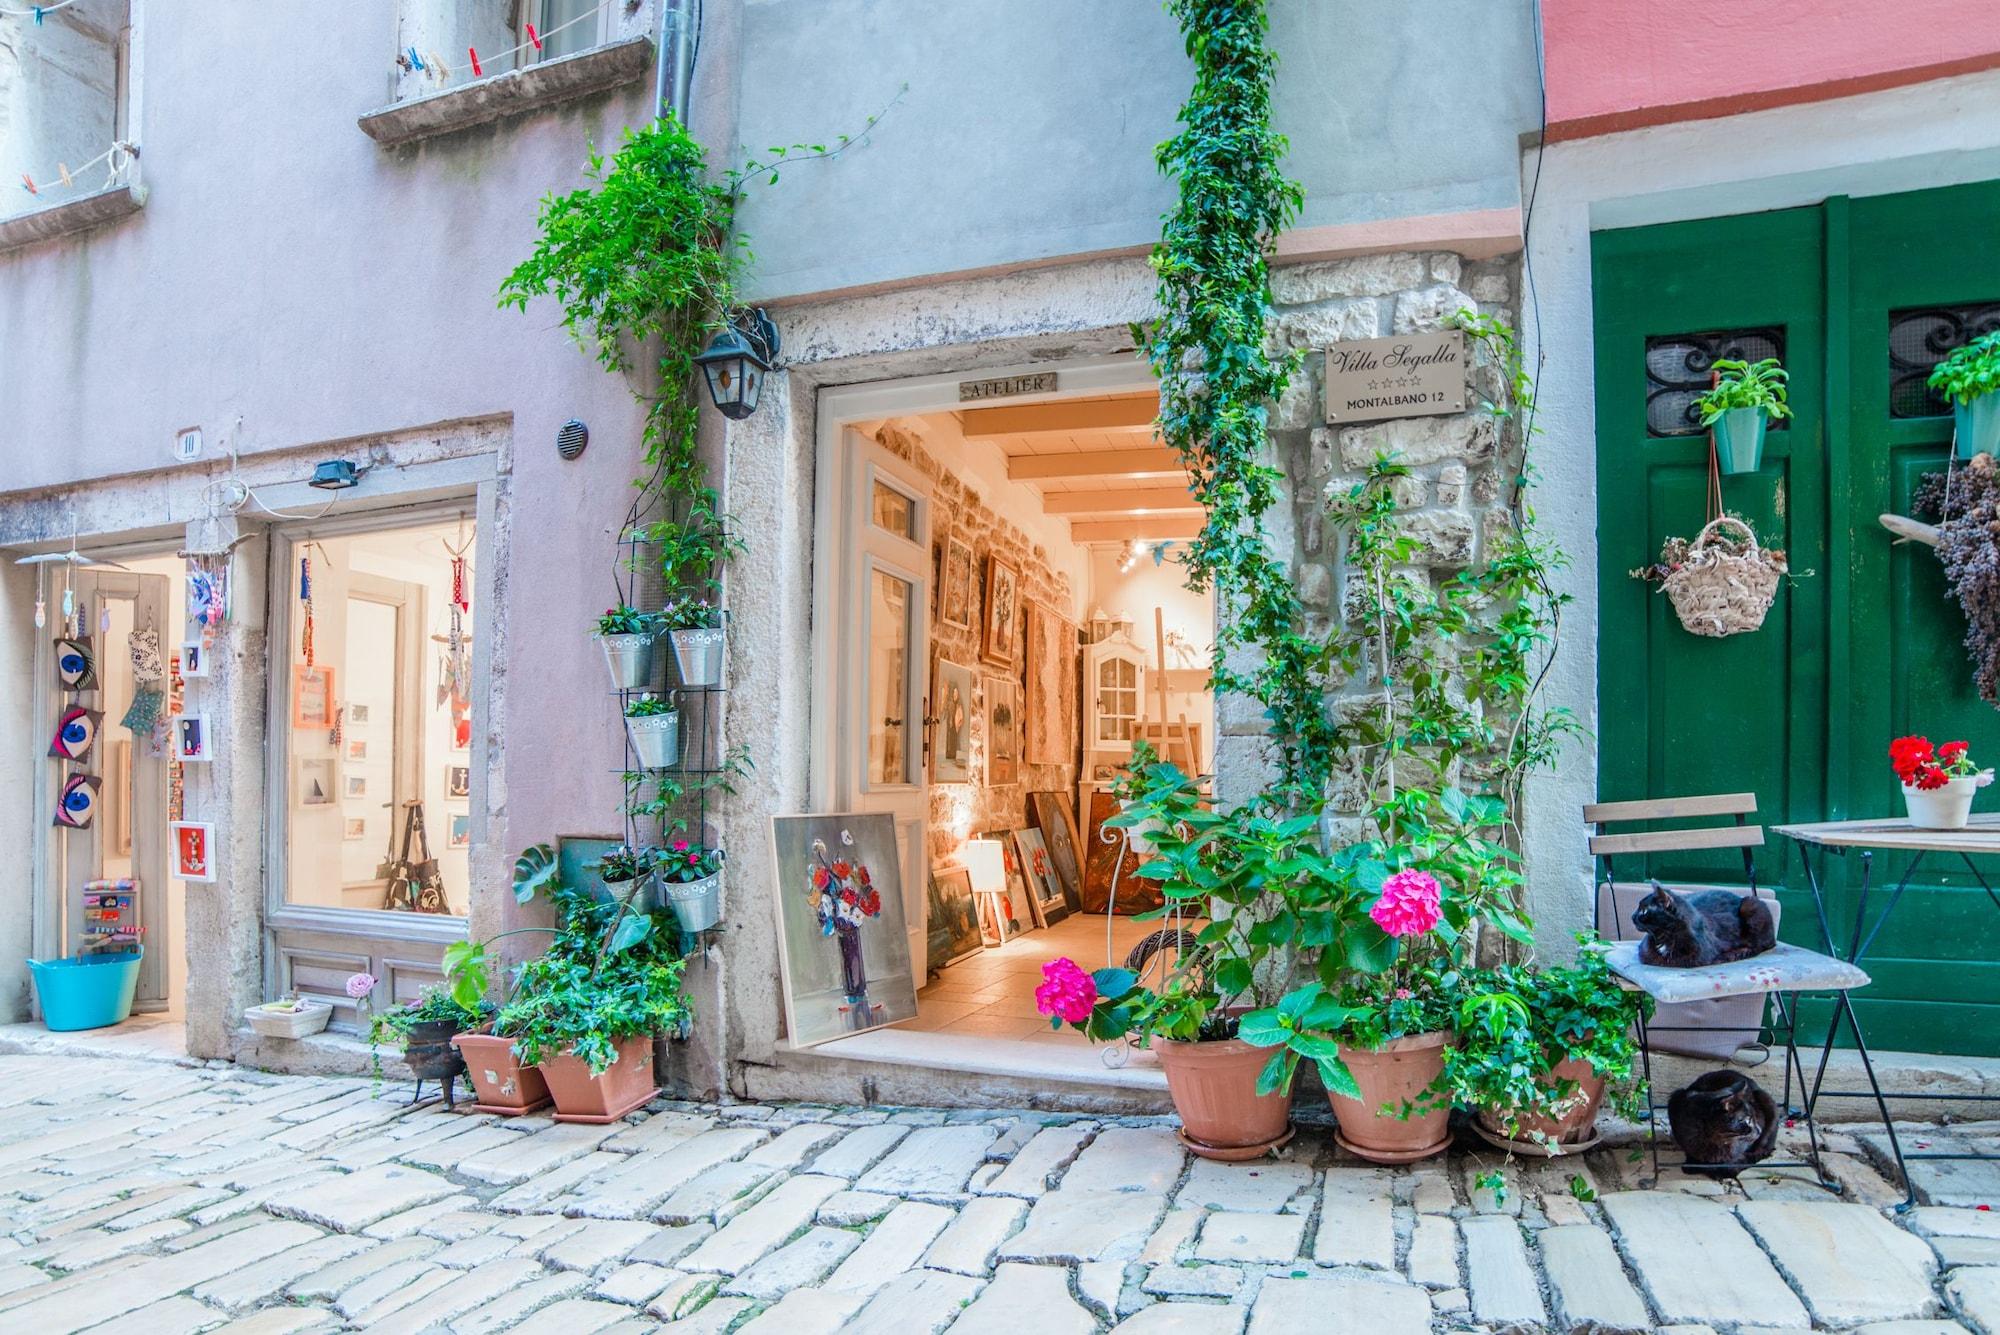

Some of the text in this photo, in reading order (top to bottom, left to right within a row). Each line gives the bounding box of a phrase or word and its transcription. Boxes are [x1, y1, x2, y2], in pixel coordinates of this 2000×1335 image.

[1333, 343, 1457, 375] Villa Segalla
[971, 377, 1045, 398] ATELIER
[1347, 391, 1445, 410] MONTALBANO 12
[184, 434, 195, 454] 10
